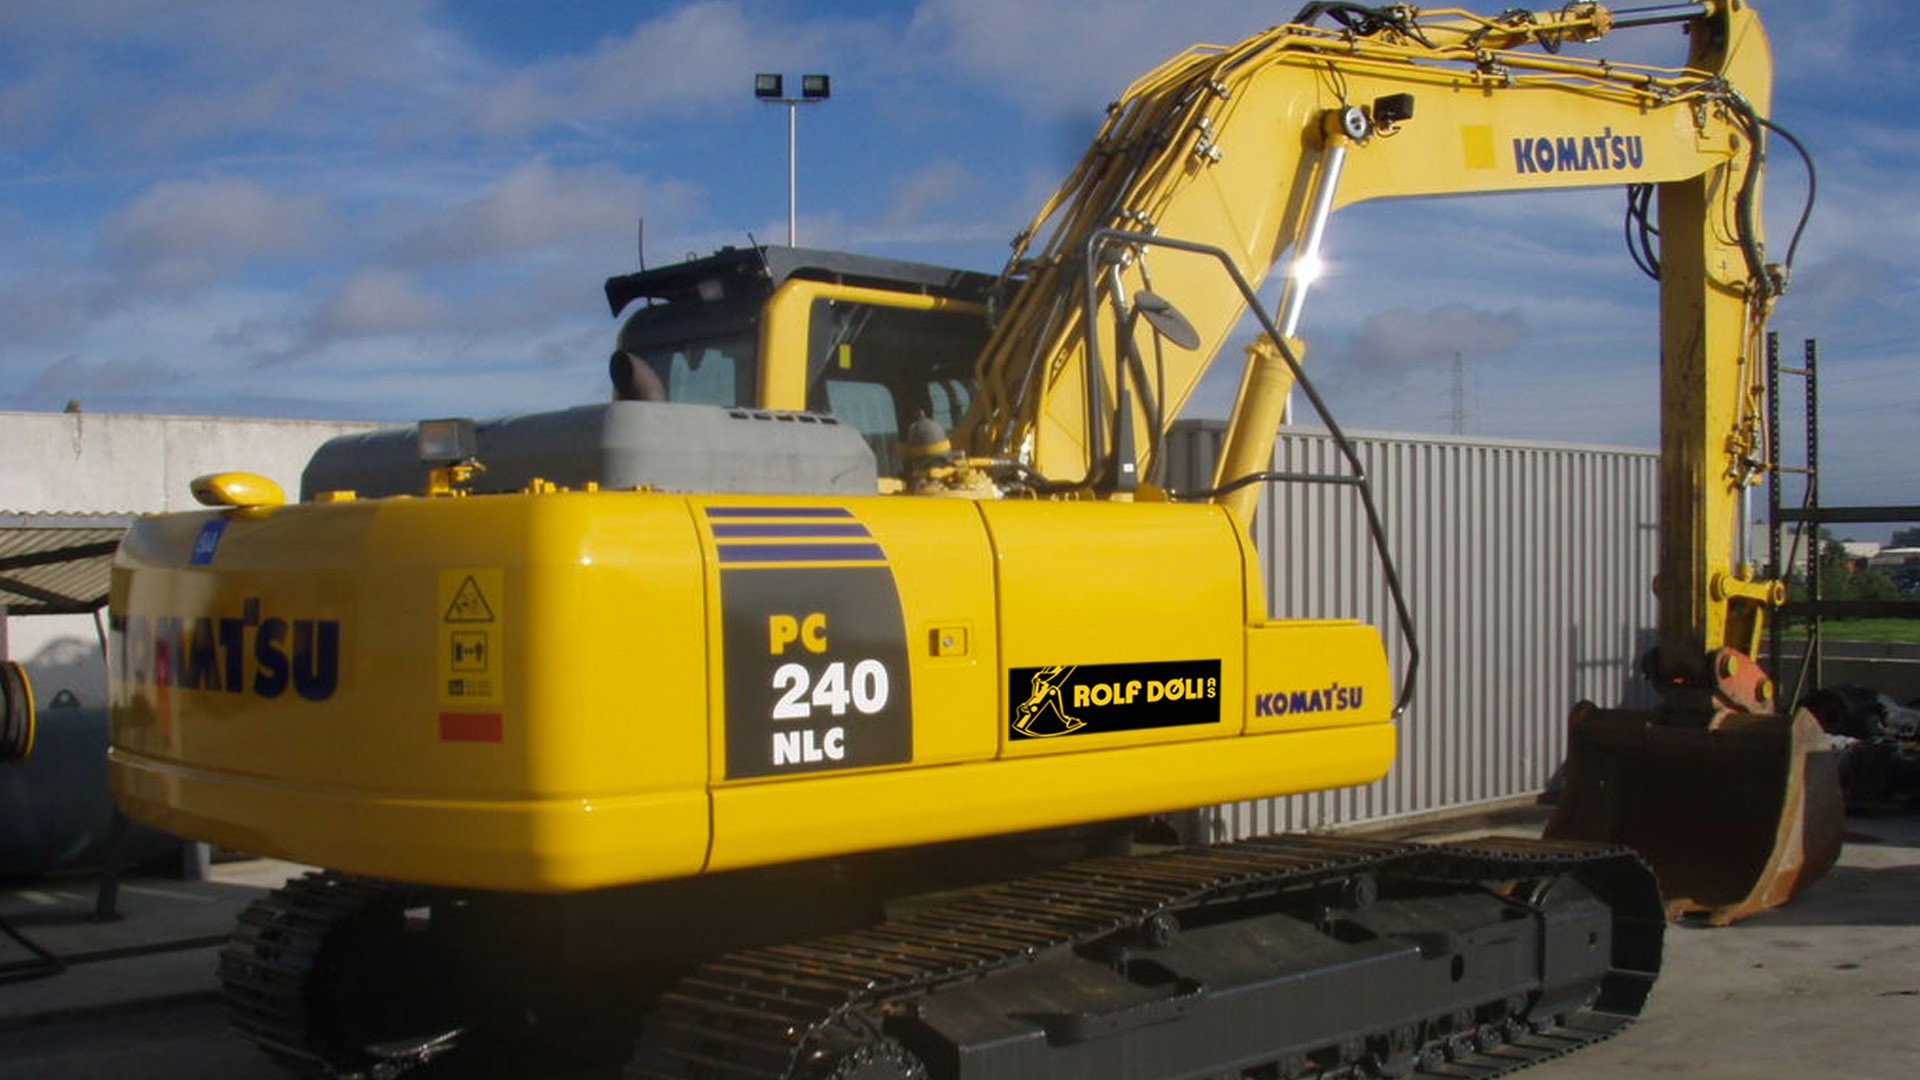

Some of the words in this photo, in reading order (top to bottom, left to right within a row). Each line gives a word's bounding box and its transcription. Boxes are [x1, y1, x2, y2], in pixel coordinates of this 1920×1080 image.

[1513, 127, 1643, 173] KOMATSU
[769, 612, 828, 655] PC
[772, 659, 889, 720] 240
[1074, 680, 1143, 708] ROLF
[1147, 677, 1204, 703] DØLI
[1255, 682, 1363, 718] KOMATSU
[772, 727, 845, 766] NLC
